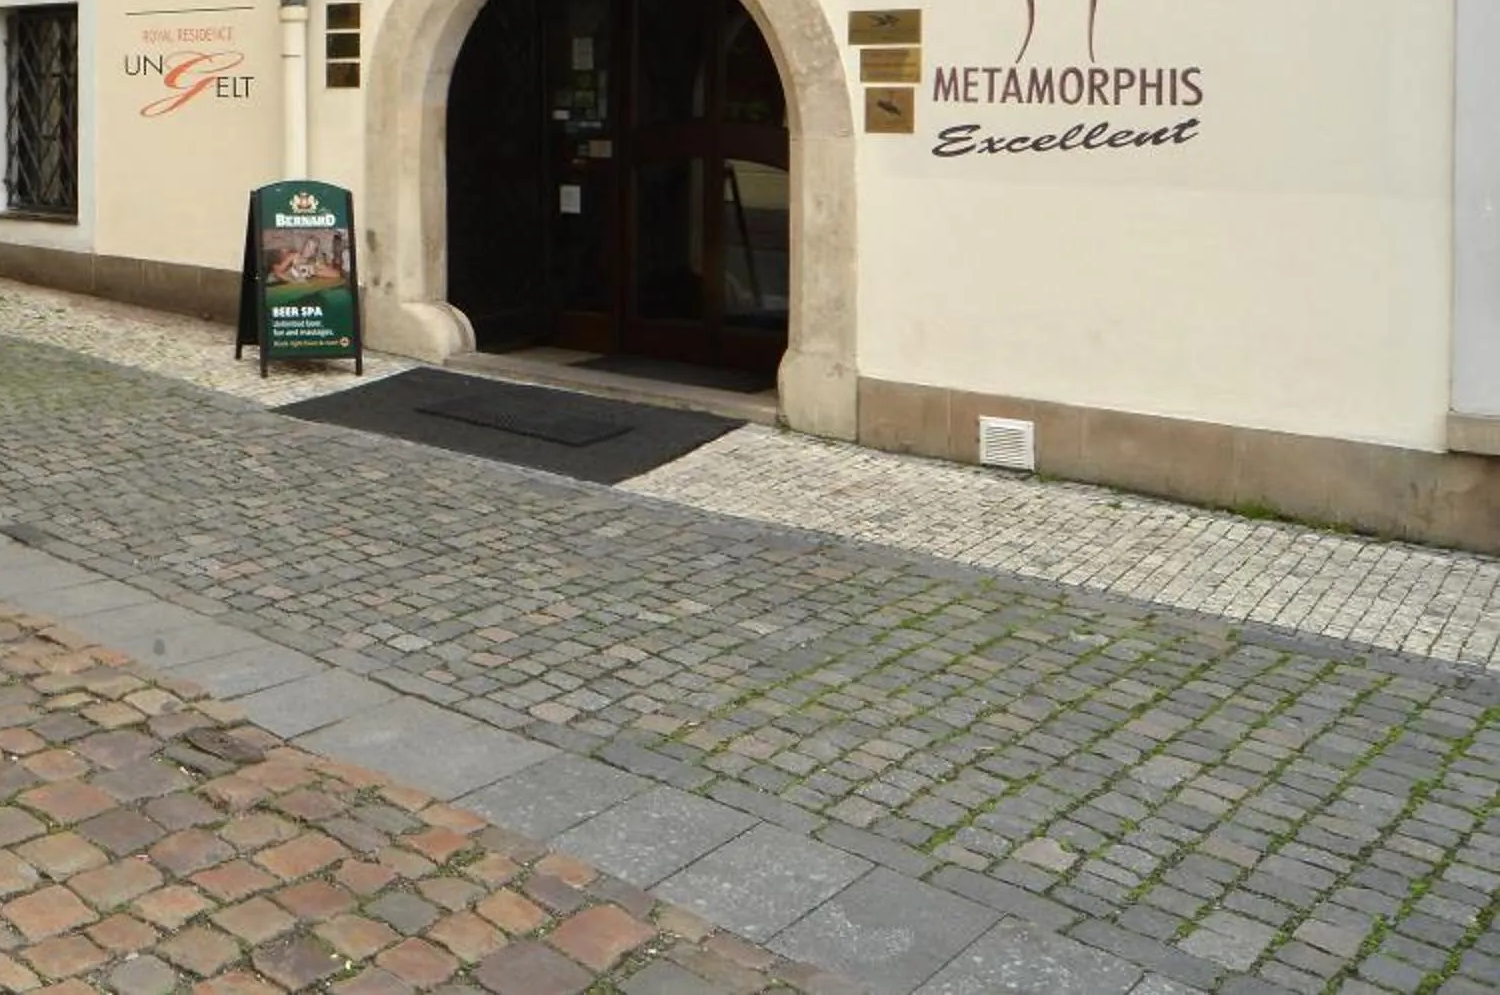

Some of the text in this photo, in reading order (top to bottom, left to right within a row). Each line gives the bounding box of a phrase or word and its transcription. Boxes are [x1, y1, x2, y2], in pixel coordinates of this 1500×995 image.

[933, 67, 1203, 106] METAMORPHIS
[931, 117, 1201, 158] Excellent
[275, 213, 336, 228] BERNARD
[272, 306, 323, 318] BEER SPA
